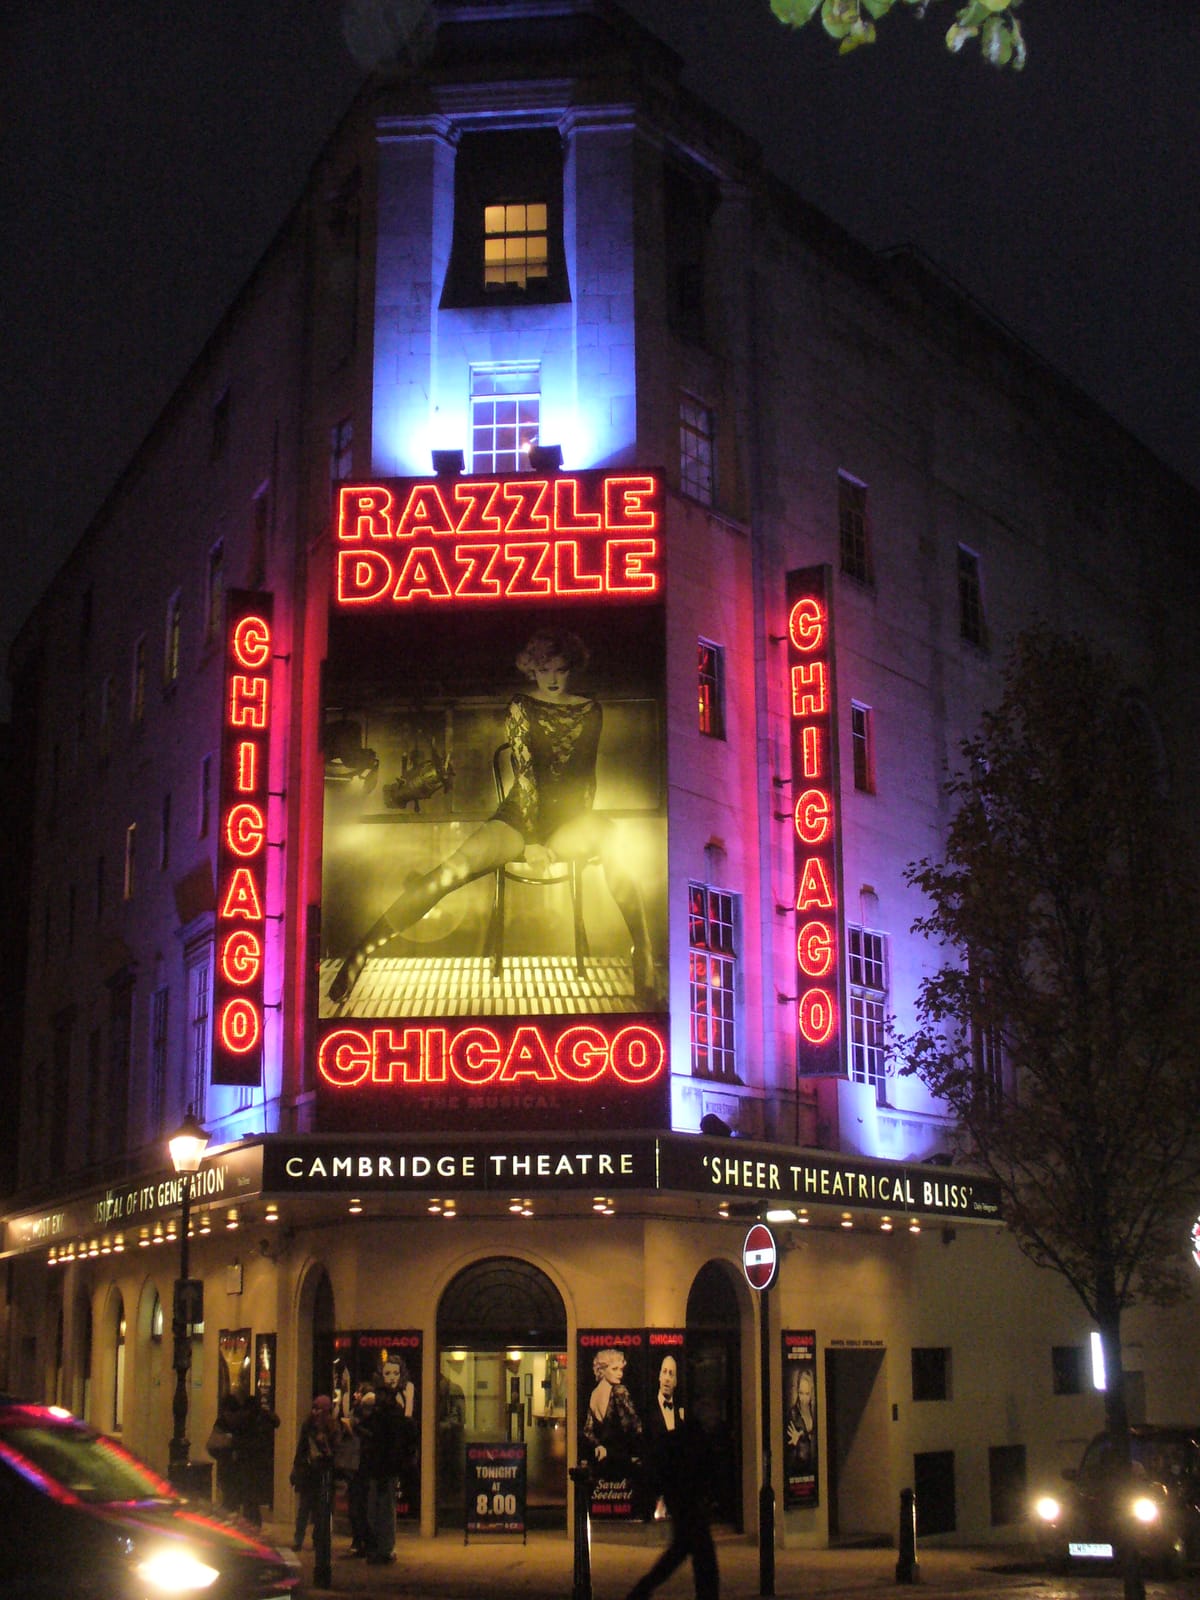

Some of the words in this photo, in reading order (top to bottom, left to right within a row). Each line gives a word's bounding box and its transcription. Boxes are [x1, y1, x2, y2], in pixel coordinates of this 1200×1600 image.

[337, 475, 657, 539] RAZZLE
[337, 538, 657, 603] DAZZLE
[221, 615, 271, 1054] CHICAGO
[789, 596, 834, 1044] CHICAGO
[317, 1026, 666, 1086] CHICAGO
[285, 1155, 475, 1178] CAMBRIDGE
[489, 1154, 634, 1177] THEATRE
[140, 1186, 155, 1212] ITS
[790, 1166, 915, 1203] THEATRICAL
[580, 1335, 642, 1346] CHICAGO
[649, 1334, 684, 1345] CHICAGO
[476, 1466, 518, 1479] TONIGHT
[476, 1494, 517, 1516] 8.00
